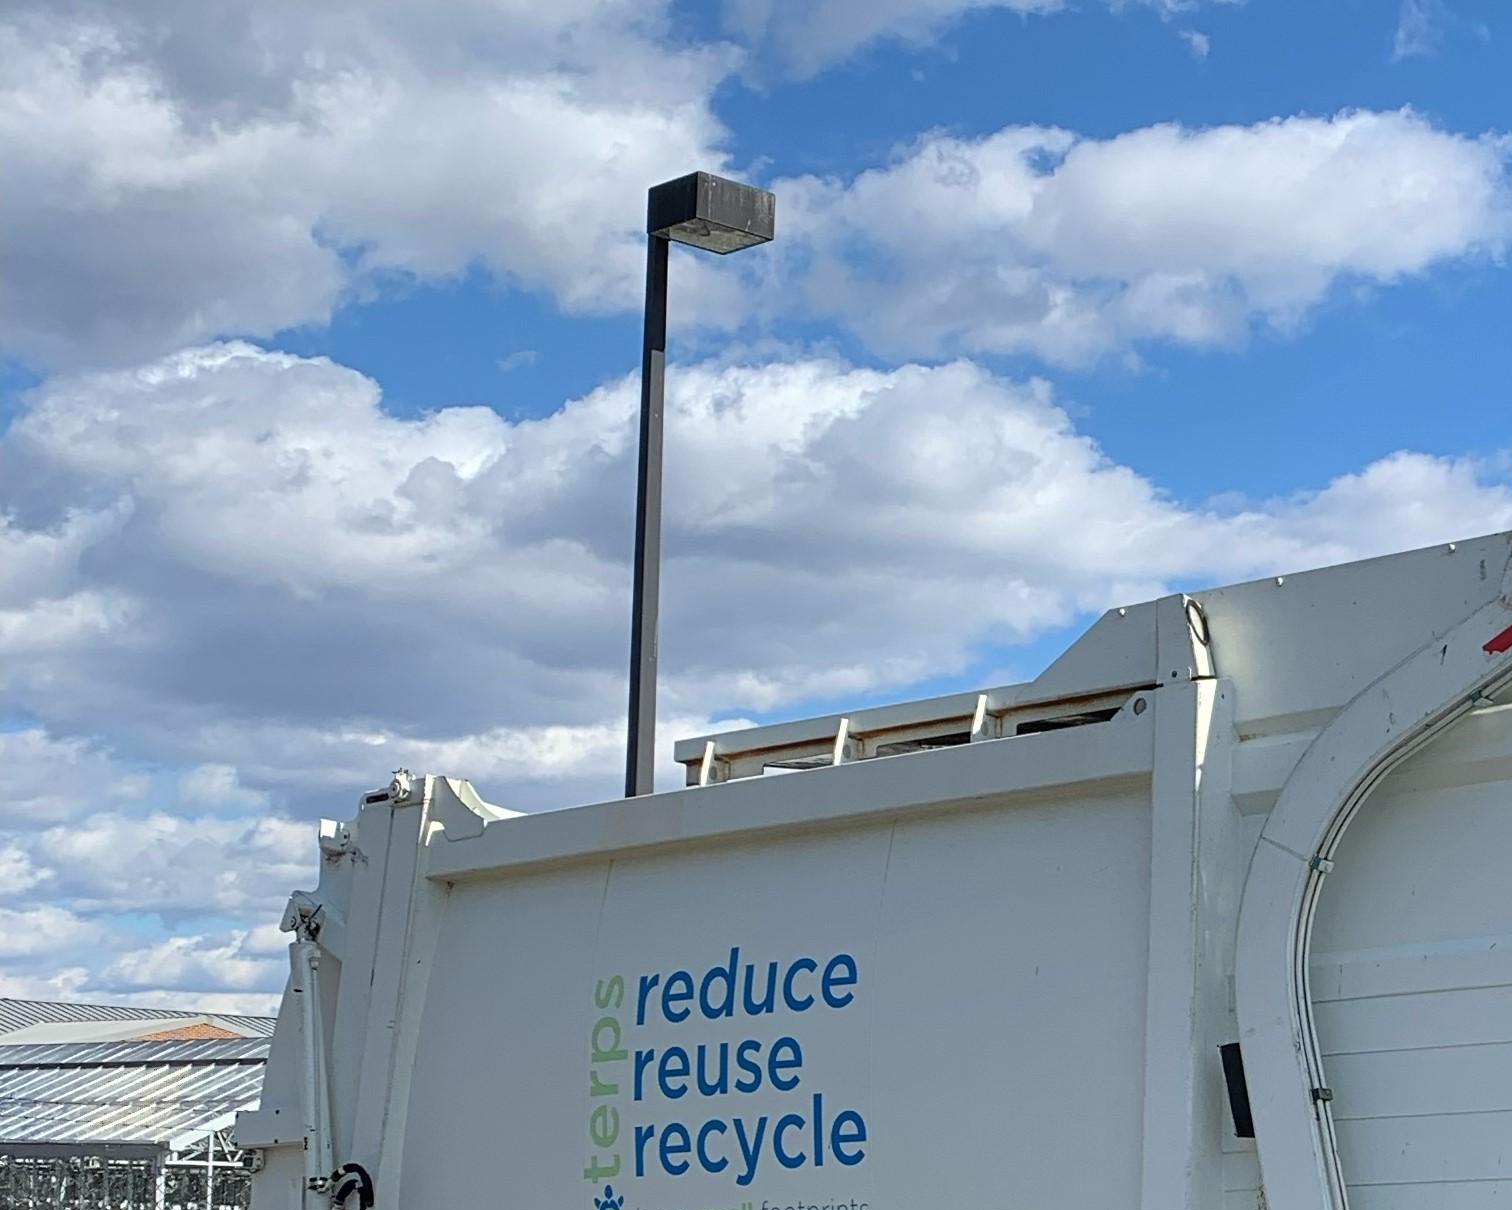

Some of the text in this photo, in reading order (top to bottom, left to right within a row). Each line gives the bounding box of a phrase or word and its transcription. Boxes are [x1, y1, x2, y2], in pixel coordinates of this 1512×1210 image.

[635, 947, 858, 1026] reduce
[583, 973, 628, 1184] terps
[633, 1036, 803, 1101] reuse
[633, 1092, 868, 1187] recycle
